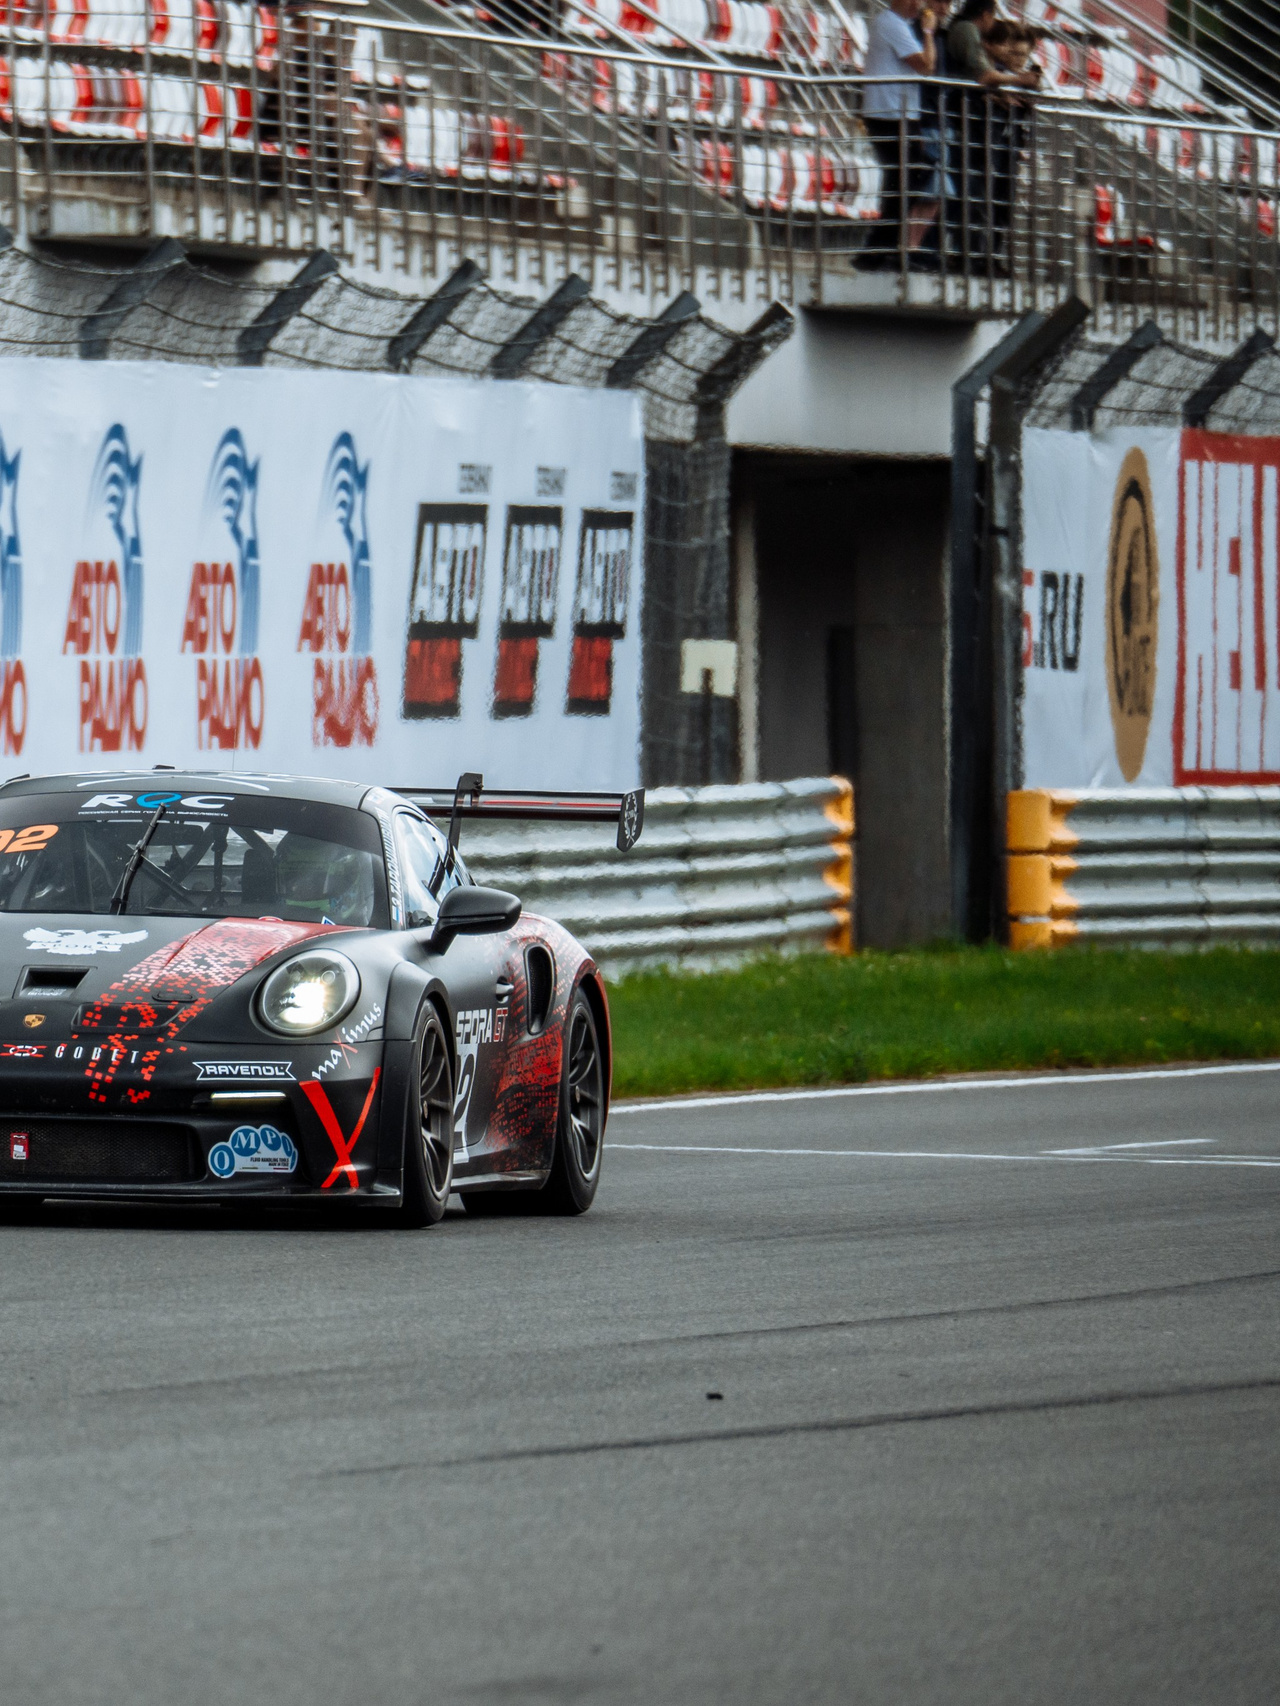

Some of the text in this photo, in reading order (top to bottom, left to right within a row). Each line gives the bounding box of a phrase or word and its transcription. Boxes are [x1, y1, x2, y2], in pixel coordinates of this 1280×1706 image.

[62, 560, 121, 656] АВТО
[180, 562, 237, 654] АВТО
[296, 562, 351, 653] АВТО
[79, 657, 148, 754] РАДИО
[197, 656, 265, 751] РАДИО
[313, 655, 380, 749] РАДИО
[55, 1045, 139, 1063] СОВЕТ
[205, 1065, 286, 1076] RAVENOL
[456, 1007, 509, 1044] SPORA GT
